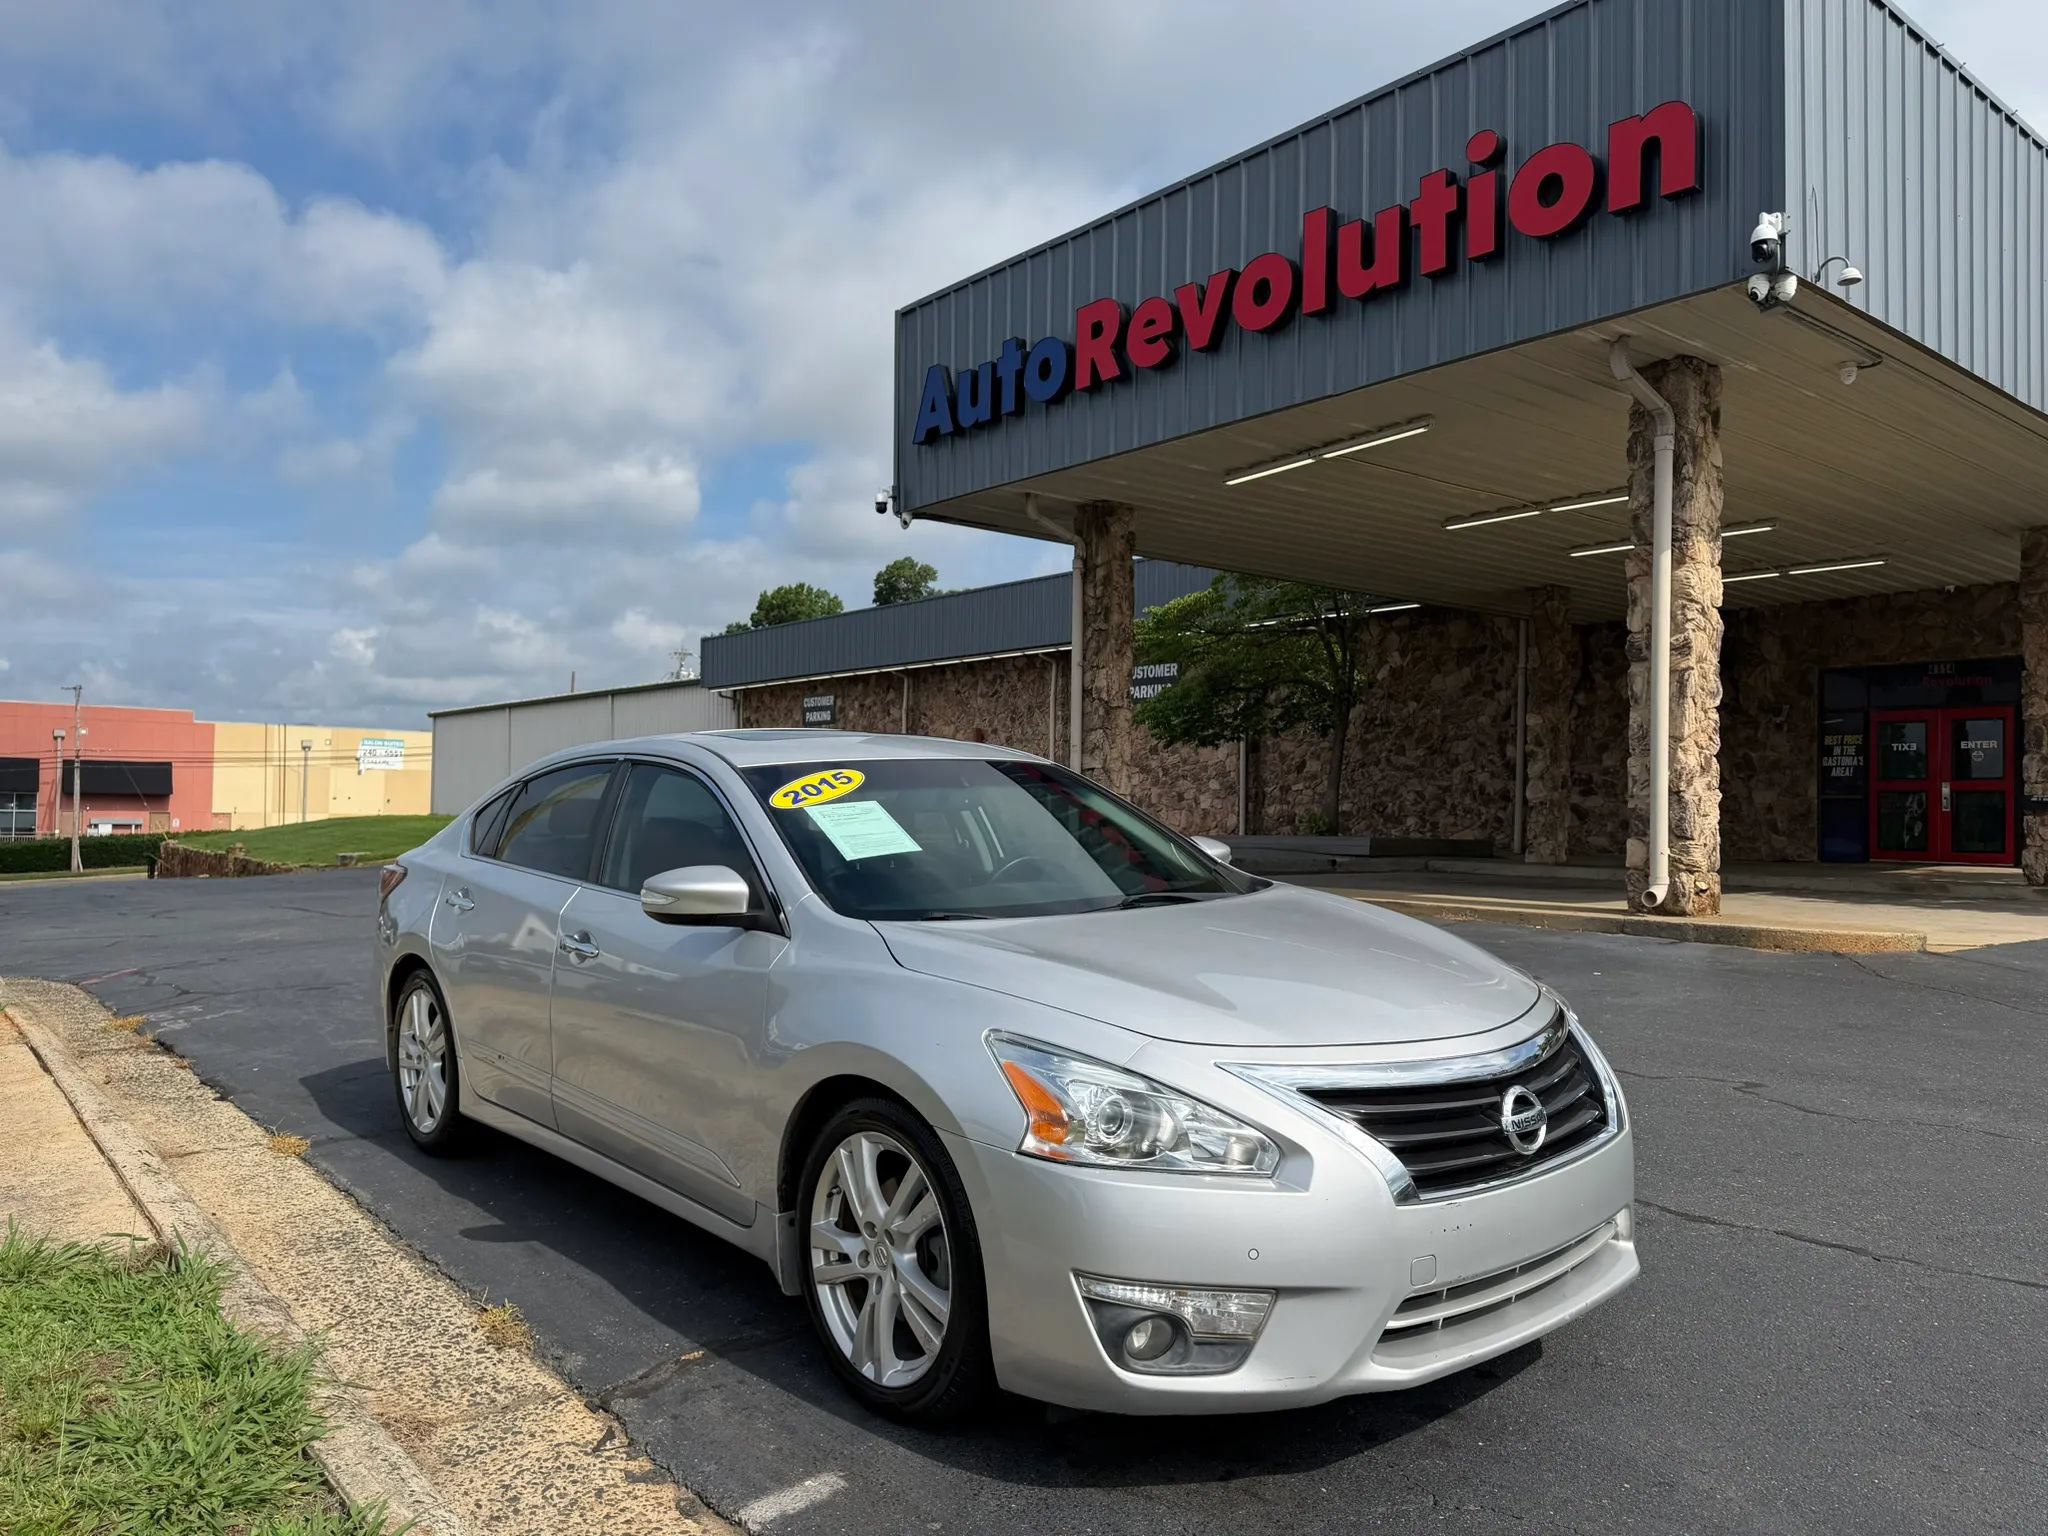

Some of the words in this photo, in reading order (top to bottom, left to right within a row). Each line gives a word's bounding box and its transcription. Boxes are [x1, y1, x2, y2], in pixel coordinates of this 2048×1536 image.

[1132, 663, 1178, 679] USTOMER
[803, 695, 834, 708] CUSTOMER
[805, 710, 831, 723] PARKING
[1824, 735, 1842, 745] BEST
[1843, 734, 1863, 744] PRICE
[1960, 740, 1998, 749] ENTER
[1833, 745, 1842, 755] IN
[1843, 745, 1856, 755] THE
[1830, 766, 1854, 776] AREA!
[783, 771, 853, 805] 2015
